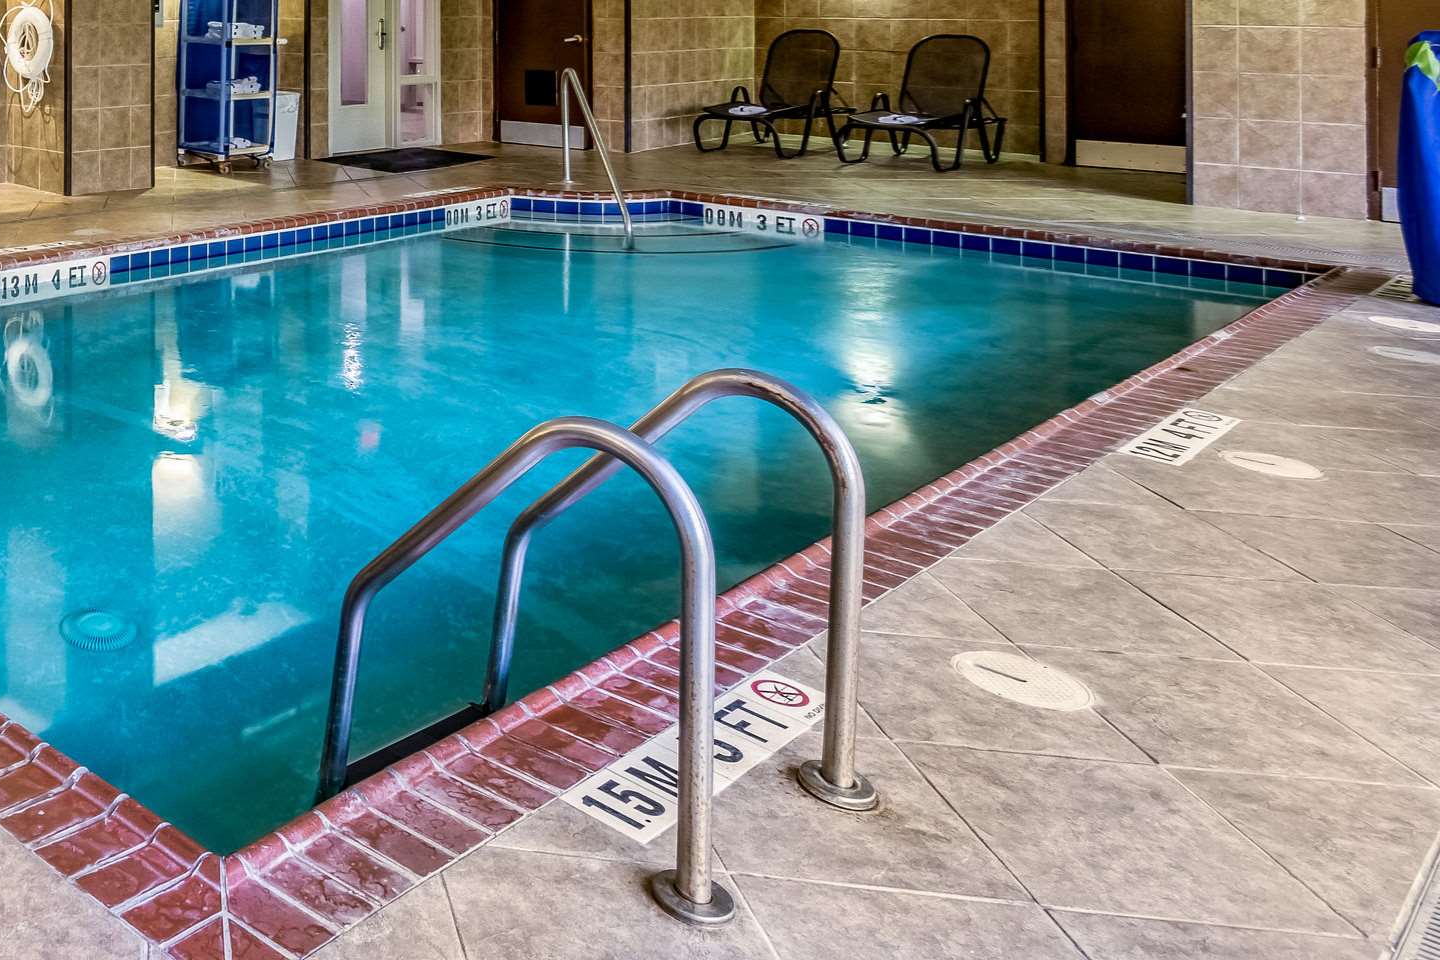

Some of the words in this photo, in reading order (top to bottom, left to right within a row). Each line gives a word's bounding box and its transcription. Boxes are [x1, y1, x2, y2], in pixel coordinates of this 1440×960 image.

[756, 214, 767, 230] 3
[1169, 418, 1219, 435] FT
[714, 698, 789, 744] FT
